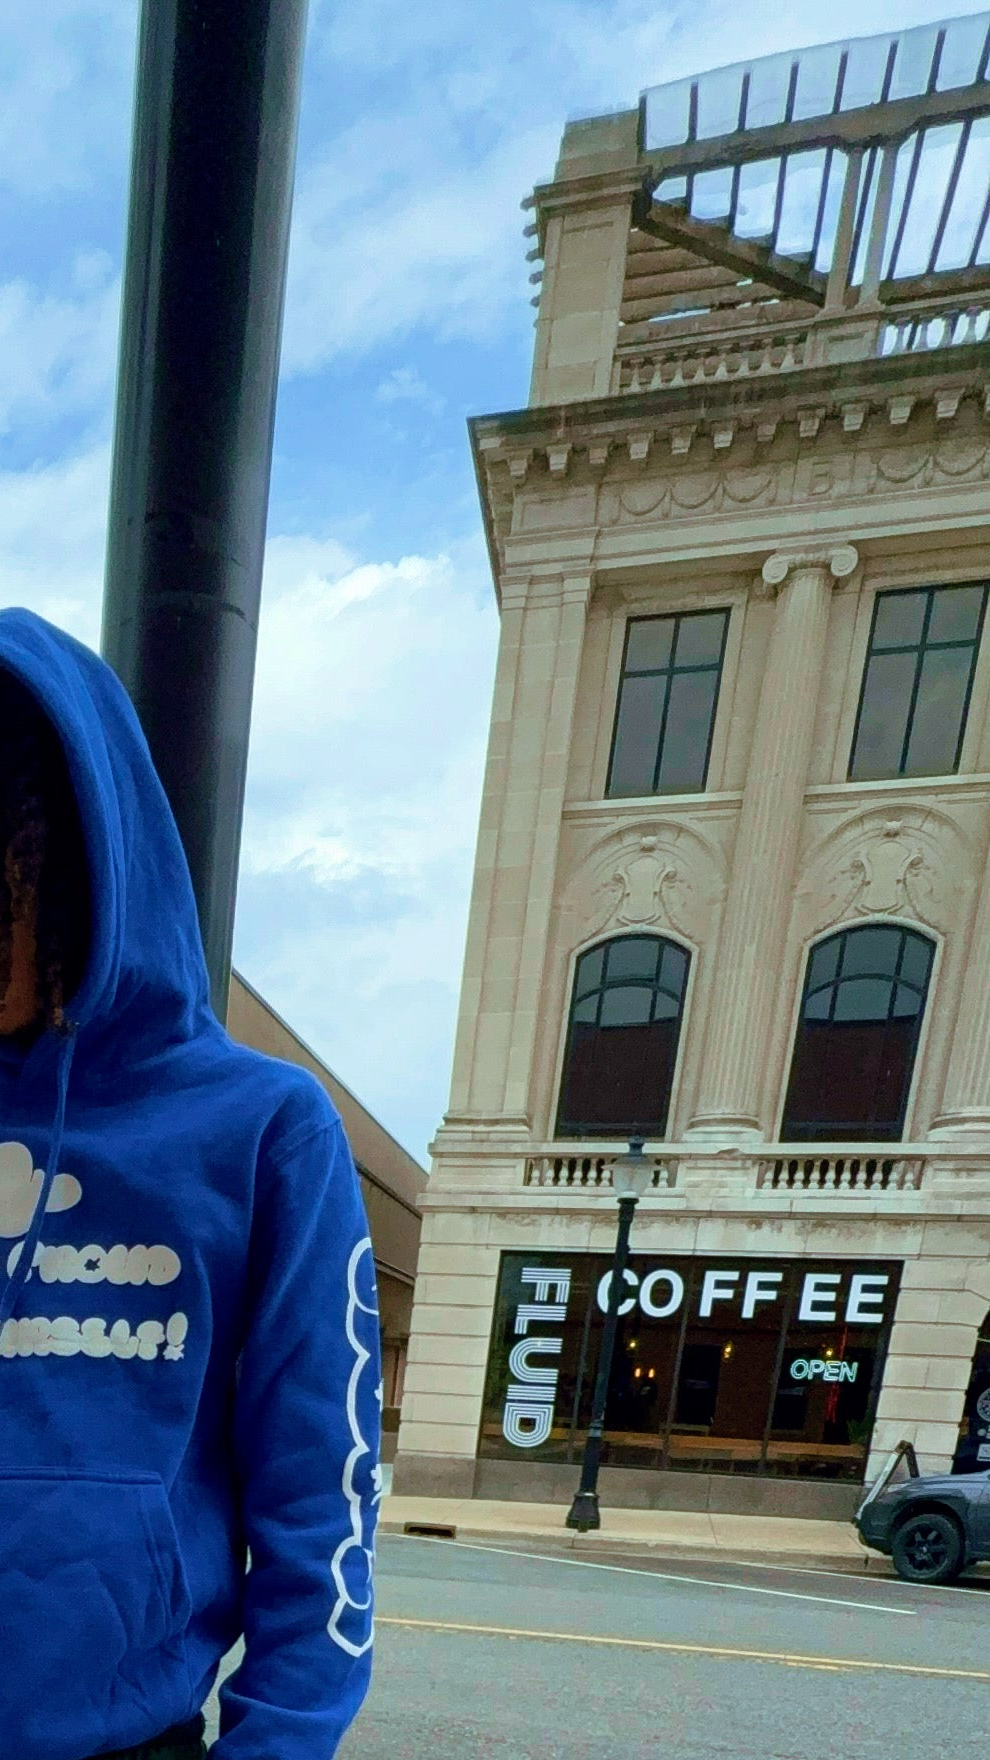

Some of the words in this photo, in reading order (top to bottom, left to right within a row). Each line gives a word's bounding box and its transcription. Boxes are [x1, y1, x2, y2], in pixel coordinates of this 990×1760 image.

[596, 1268, 889, 1324] COFFEE
[502, 1267, 572, 1448] FLUID
[790, 1358, 859, 1383] OPEN
